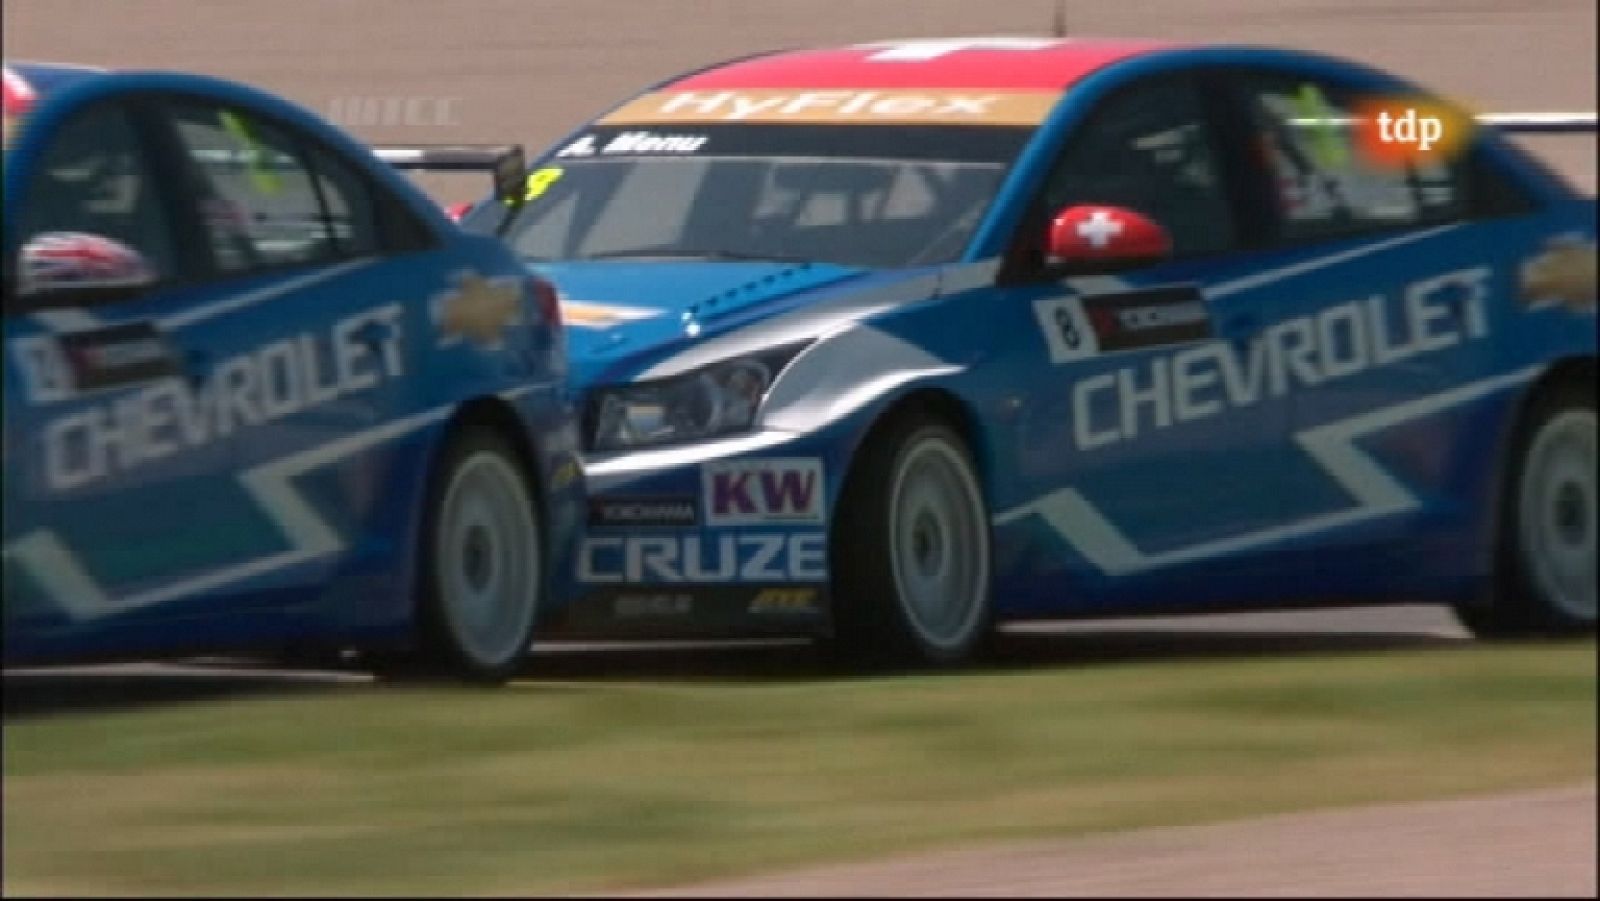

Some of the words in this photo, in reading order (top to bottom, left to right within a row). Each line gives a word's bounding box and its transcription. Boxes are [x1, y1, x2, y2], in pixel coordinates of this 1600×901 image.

[659, 89, 1001, 119] HyFlex
[1054, 306, 1081, 350] 8
[1072, 267, 1493, 450] CHEVROLET
[45, 303, 404, 488] CHEVROLET
[711, 468, 816, 515] KW
[578, 532, 828, 583] CRUZE
